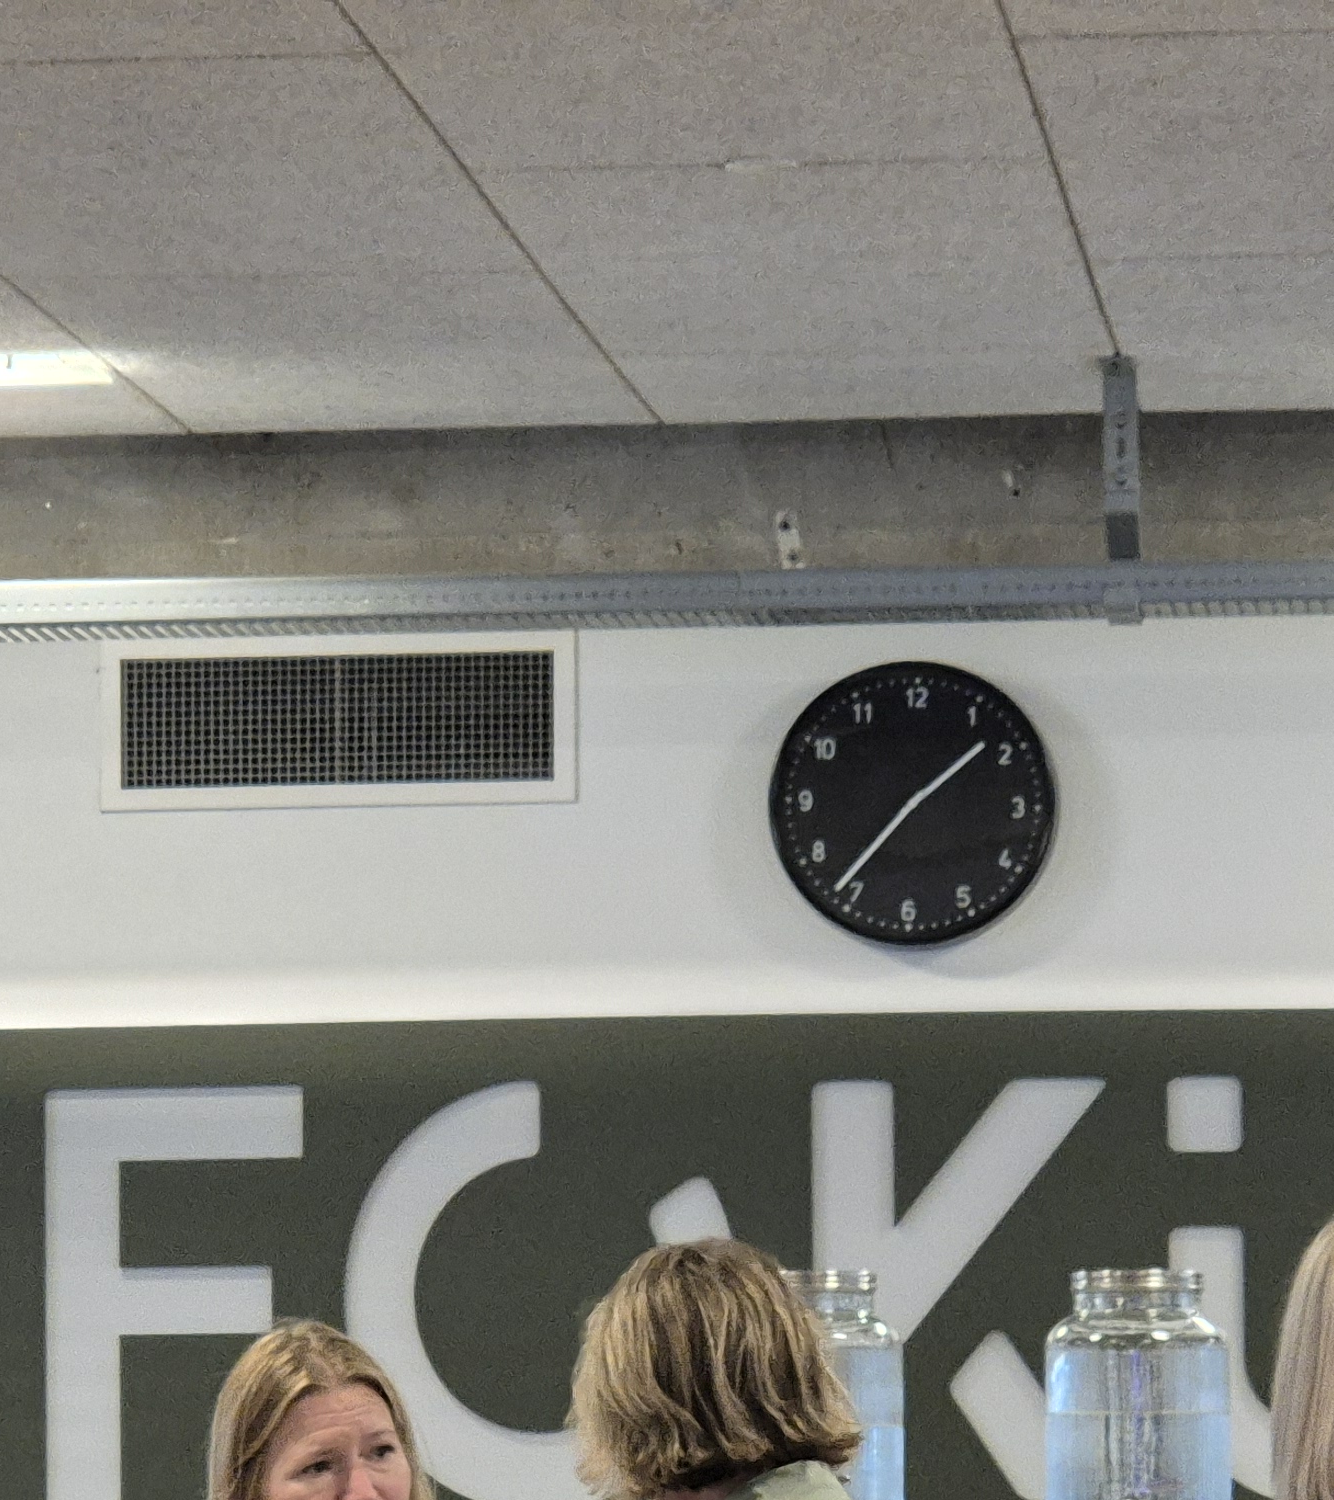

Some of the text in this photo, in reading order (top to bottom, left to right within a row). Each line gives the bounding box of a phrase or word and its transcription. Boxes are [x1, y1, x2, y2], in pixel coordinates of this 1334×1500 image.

[905, 686, 929, 709] 12
[853, 702, 873, 724] 11
[967, 705, 977, 727] 1
[814, 737, 836, 760] 10
[997, 741, 1013, 766] 2
[798, 789, 814, 812] 9
[1011, 796, 1026, 819] 3
[812, 840, 826, 863] 8
[998, 849, 1012, 870] 4
[849, 881, 864, 903] 7
[955, 884, 972, 908] 5
[901, 899, 916, 922] 6
